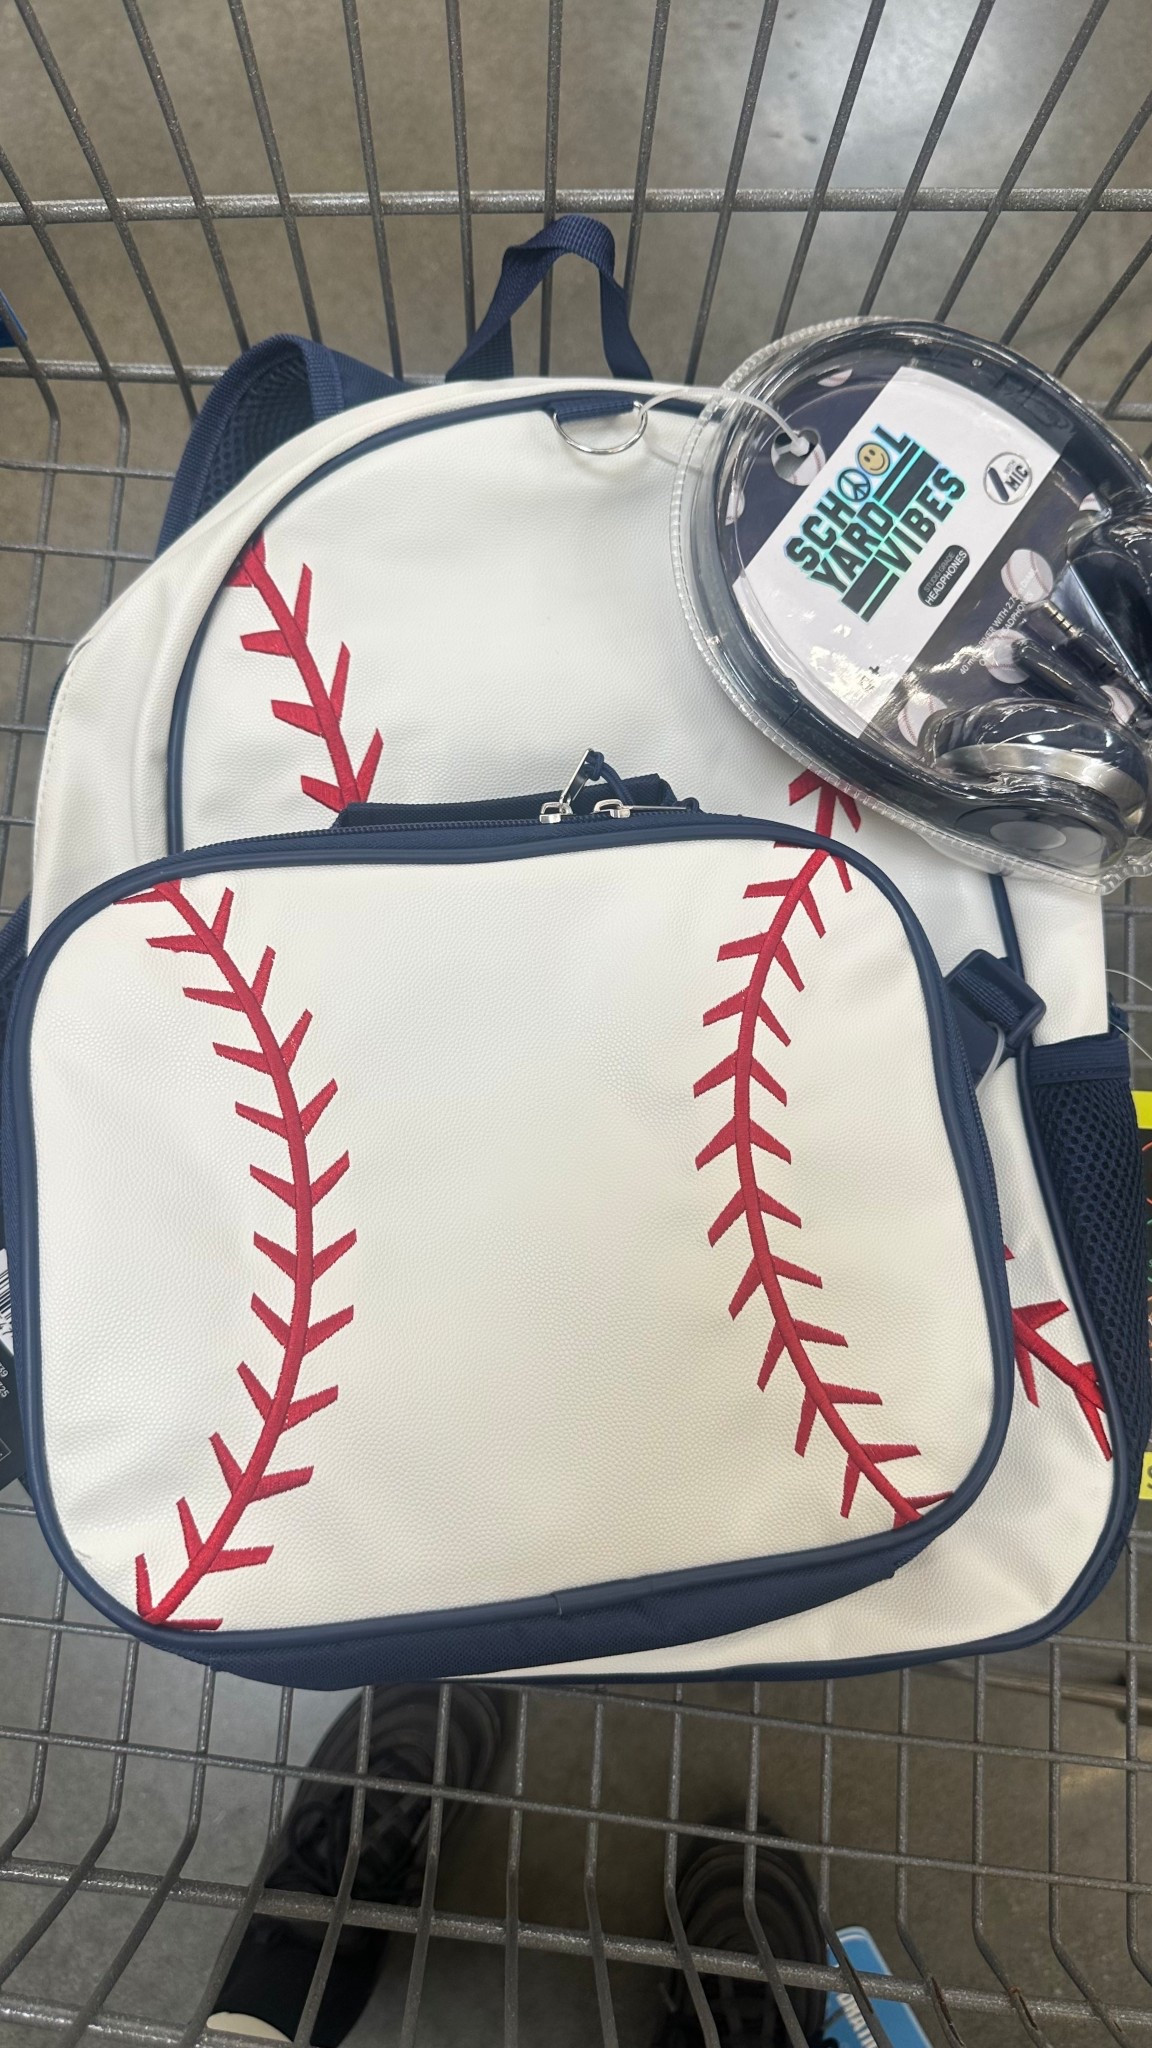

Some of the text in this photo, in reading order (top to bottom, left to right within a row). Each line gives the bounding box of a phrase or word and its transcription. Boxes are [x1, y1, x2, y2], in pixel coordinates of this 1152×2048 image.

[1005, 465, 1028, 492] MIC
[810, 502, 894, 593] YARD
[874, 468, 965, 573] VIBES
[924, 551, 955, 592] STUDIO GRADE
[925, 550, 967, 605] HEADPHONES
[960, 664, 969, 676] 40
[992, 606, 1009, 628] WITH
